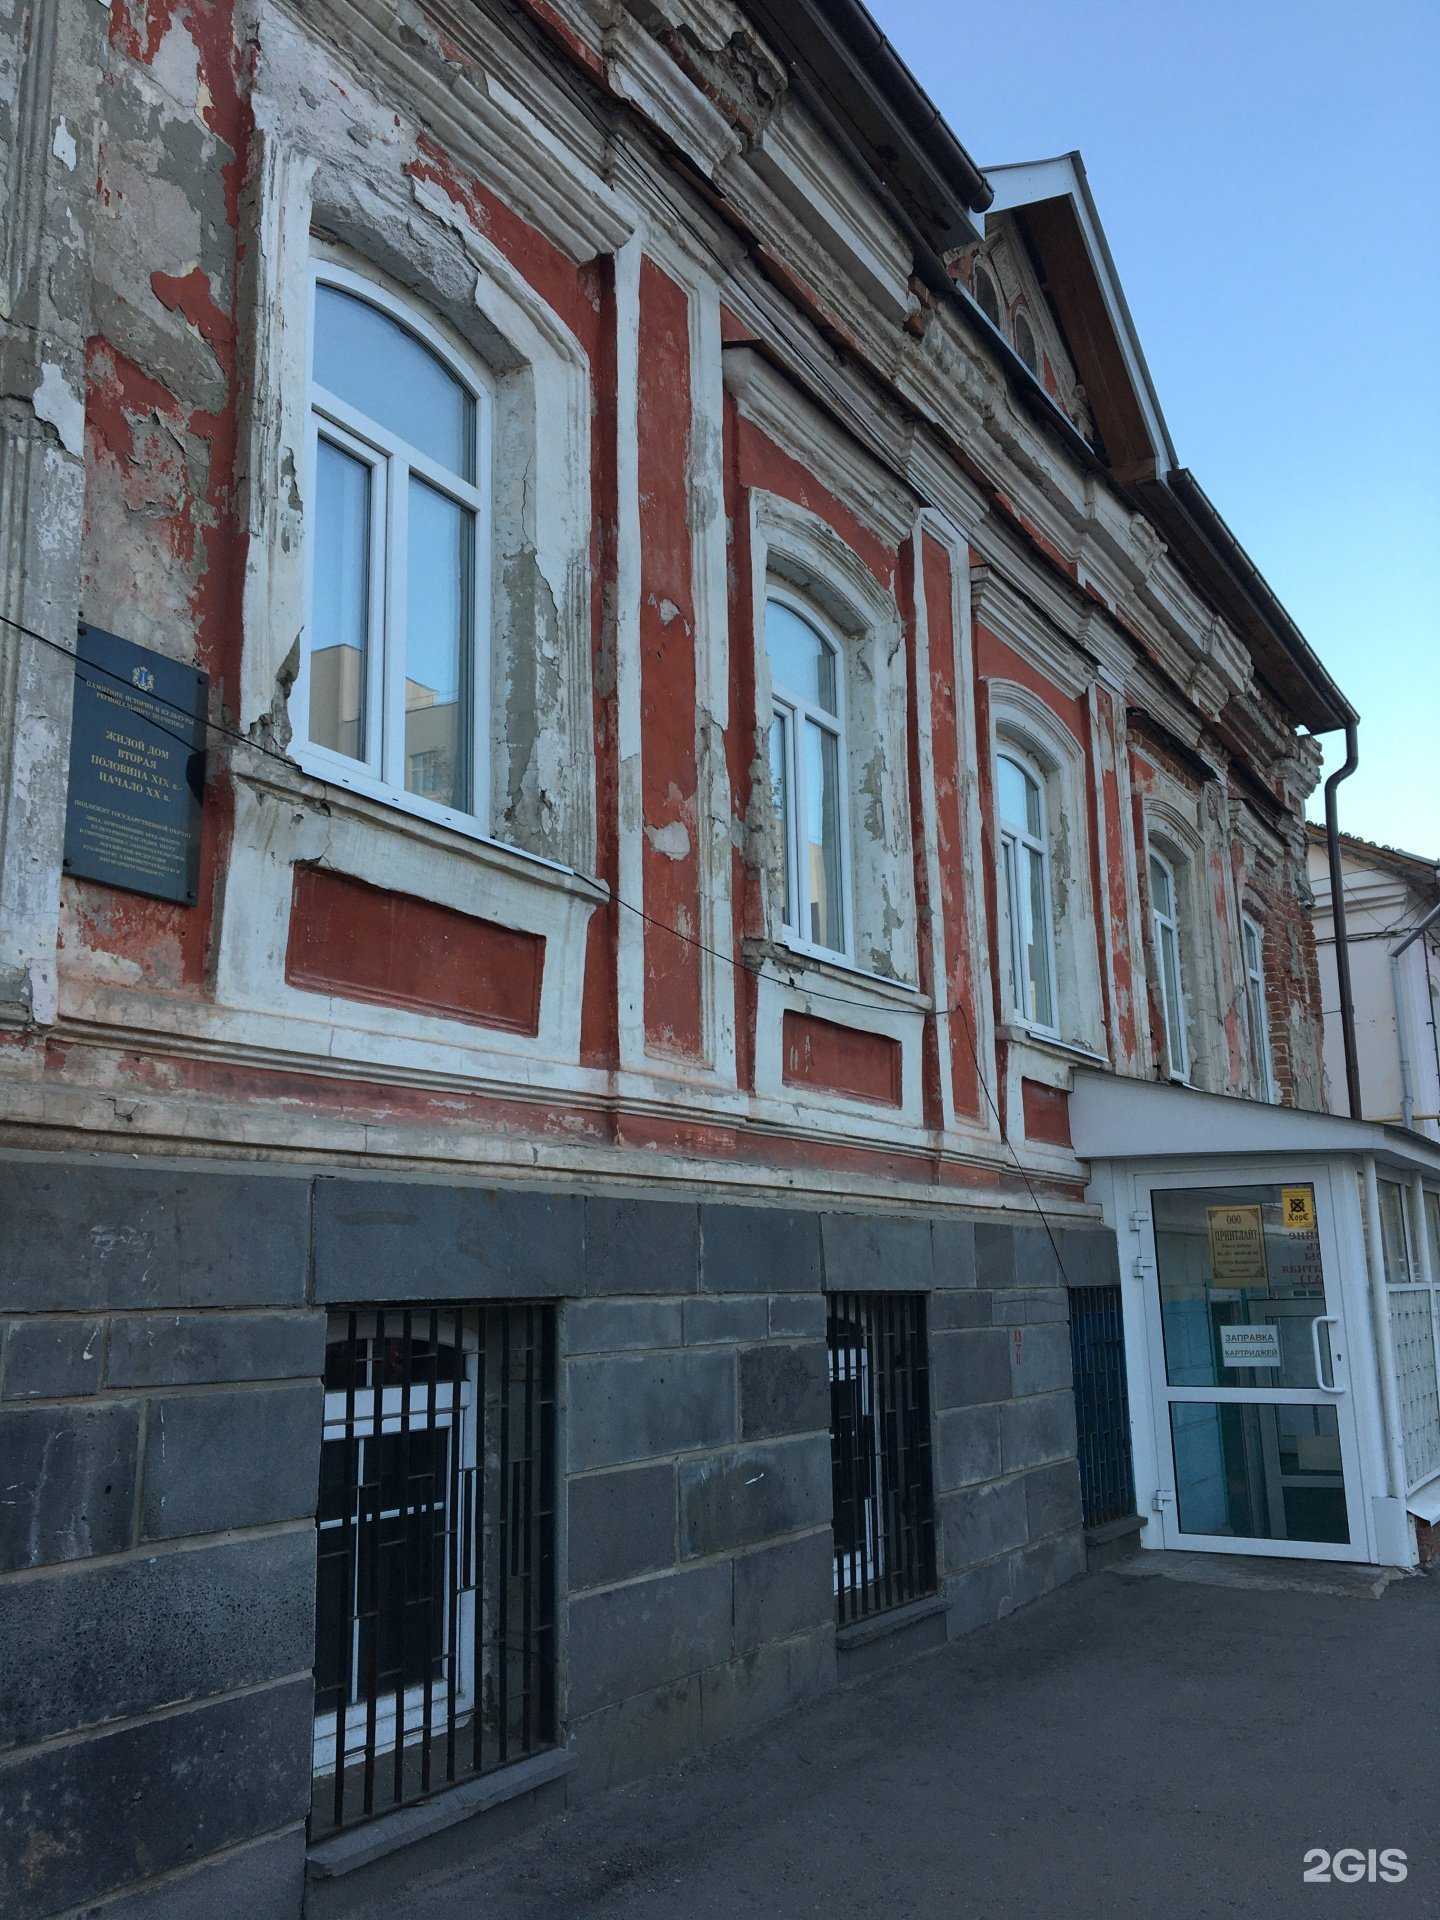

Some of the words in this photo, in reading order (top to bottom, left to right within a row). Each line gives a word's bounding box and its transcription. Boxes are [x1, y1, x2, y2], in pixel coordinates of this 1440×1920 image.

[105, 729, 145, 751] ЖИЛОЙ
[147, 744, 169, 760] ДОМ
[91, 754, 147, 781] ПОЛОВИНА
[117, 748, 156, 769] ВТОРАЯ
[98, 771, 142, 793] НАЧАЛО
[1225, 1334, 1274, 1342] ЗАПРАВКА
[1225, 1348, 1278, 1357] КАРТРИДЖЕЙ
